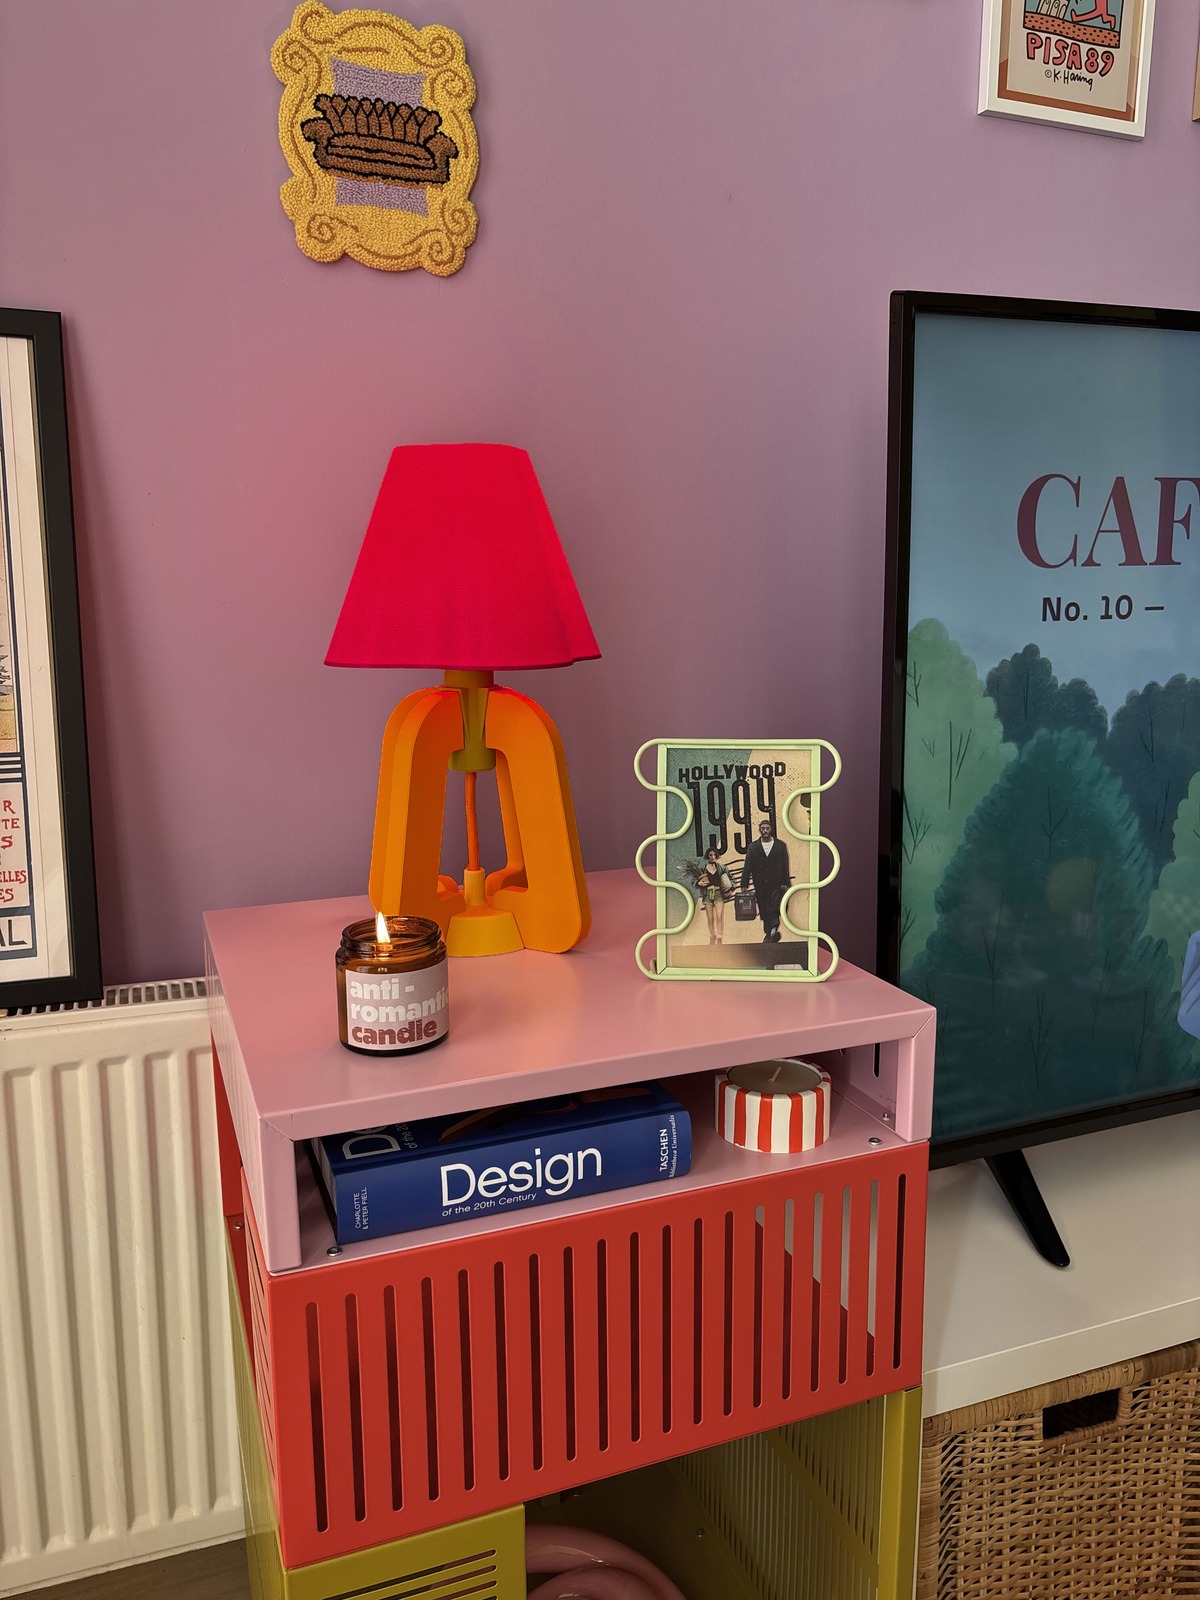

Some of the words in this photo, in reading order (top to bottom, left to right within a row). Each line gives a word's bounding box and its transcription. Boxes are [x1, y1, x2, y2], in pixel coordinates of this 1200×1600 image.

[1041, 596, 1088, 622] No.
[1100, 594, 1133, 620] 10
[678, 761, 786, 783] HOLLYWOOD
[1, 818, 20, 830] TE
[349, 977, 400, 1000] anti
[351, 1018, 438, 1046] candle
[659, 1128, 669, 1172] TASCHEN
[440, 1147, 602, 1207] Design
[353, 1192, 361, 1229] CHARLOTTE
[442, 1207, 453, 1217] of
[455, 1204, 471, 1215] the
[473, 1200, 496, 1211] 20th
[498, 1193, 538, 1206] Century
